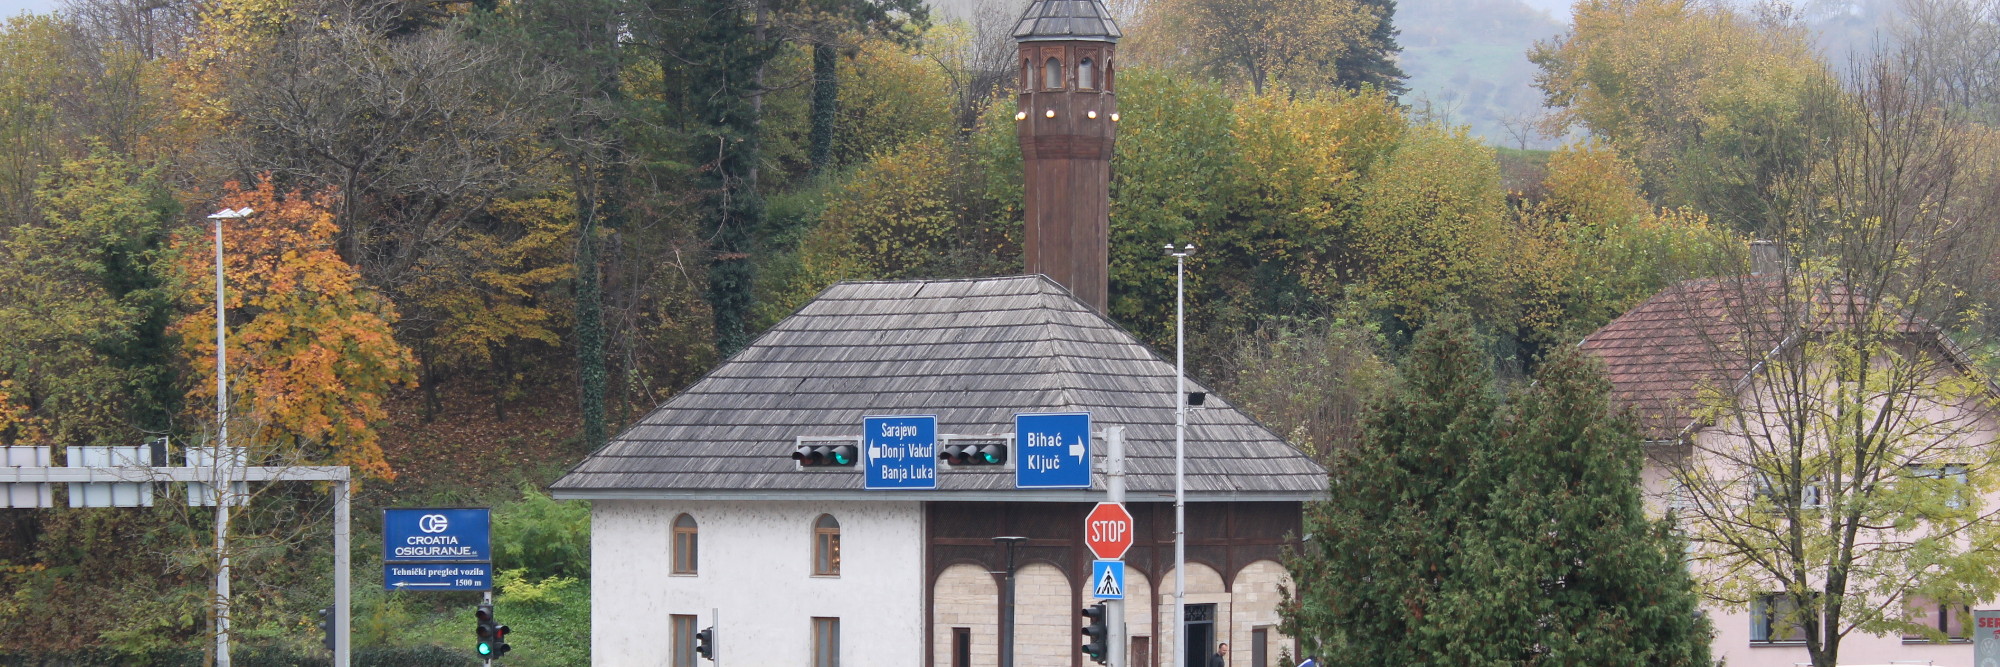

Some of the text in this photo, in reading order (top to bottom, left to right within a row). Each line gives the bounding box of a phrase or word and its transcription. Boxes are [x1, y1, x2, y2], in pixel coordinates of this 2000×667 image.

[881, 422, 917, 440] Sarajevo
[1027, 432, 1062, 447] Bihać
[881, 443, 933, 461] Donji Vakuf
[1027, 454, 1060, 473] Ključ
[881, 464, 933, 482] Banja Luka
[1091, 520, 1126, 543] STOP
[406, 536, 458, 545] CROATIA
[395, 546, 471, 556] OSIGURANJE
[392, 567, 484, 577] Tehnički pregled vozila
[455, 579, 472, 587] 1500
